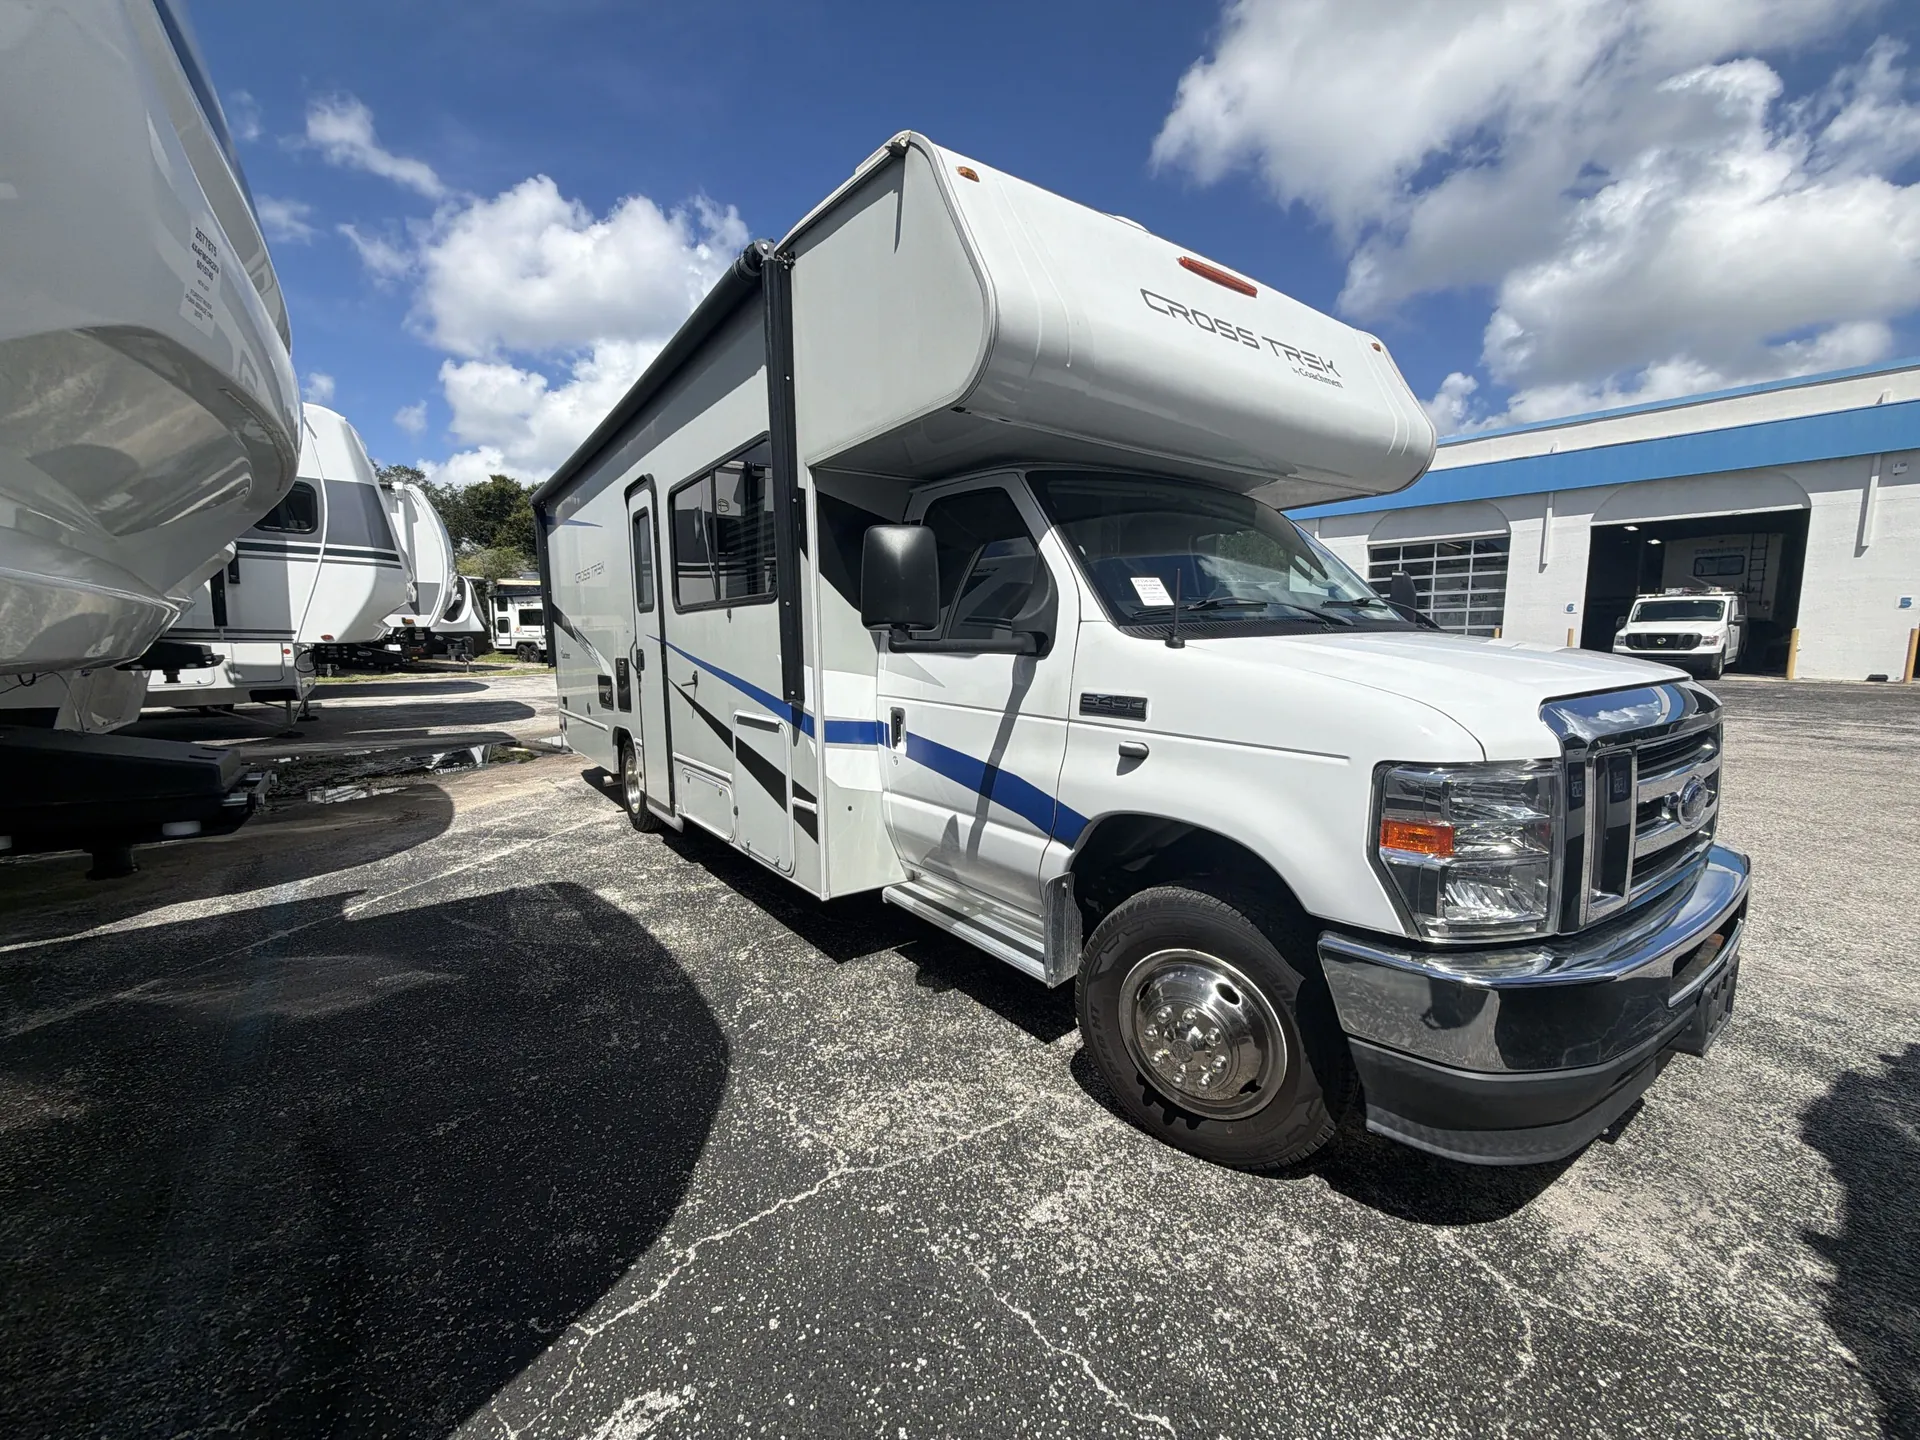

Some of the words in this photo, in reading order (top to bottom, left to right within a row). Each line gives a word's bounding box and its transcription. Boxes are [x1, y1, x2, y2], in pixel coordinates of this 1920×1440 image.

[1140, 288, 1260, 350] CROSS
[1261, 336, 1342, 377] TREK
[1298, 367, 1344, 389] Coachmen
[575, 568, 591, 584] CROSS
[1566, 603, 1575, 613] 6
[1899, 597, 1912, 609] 5
